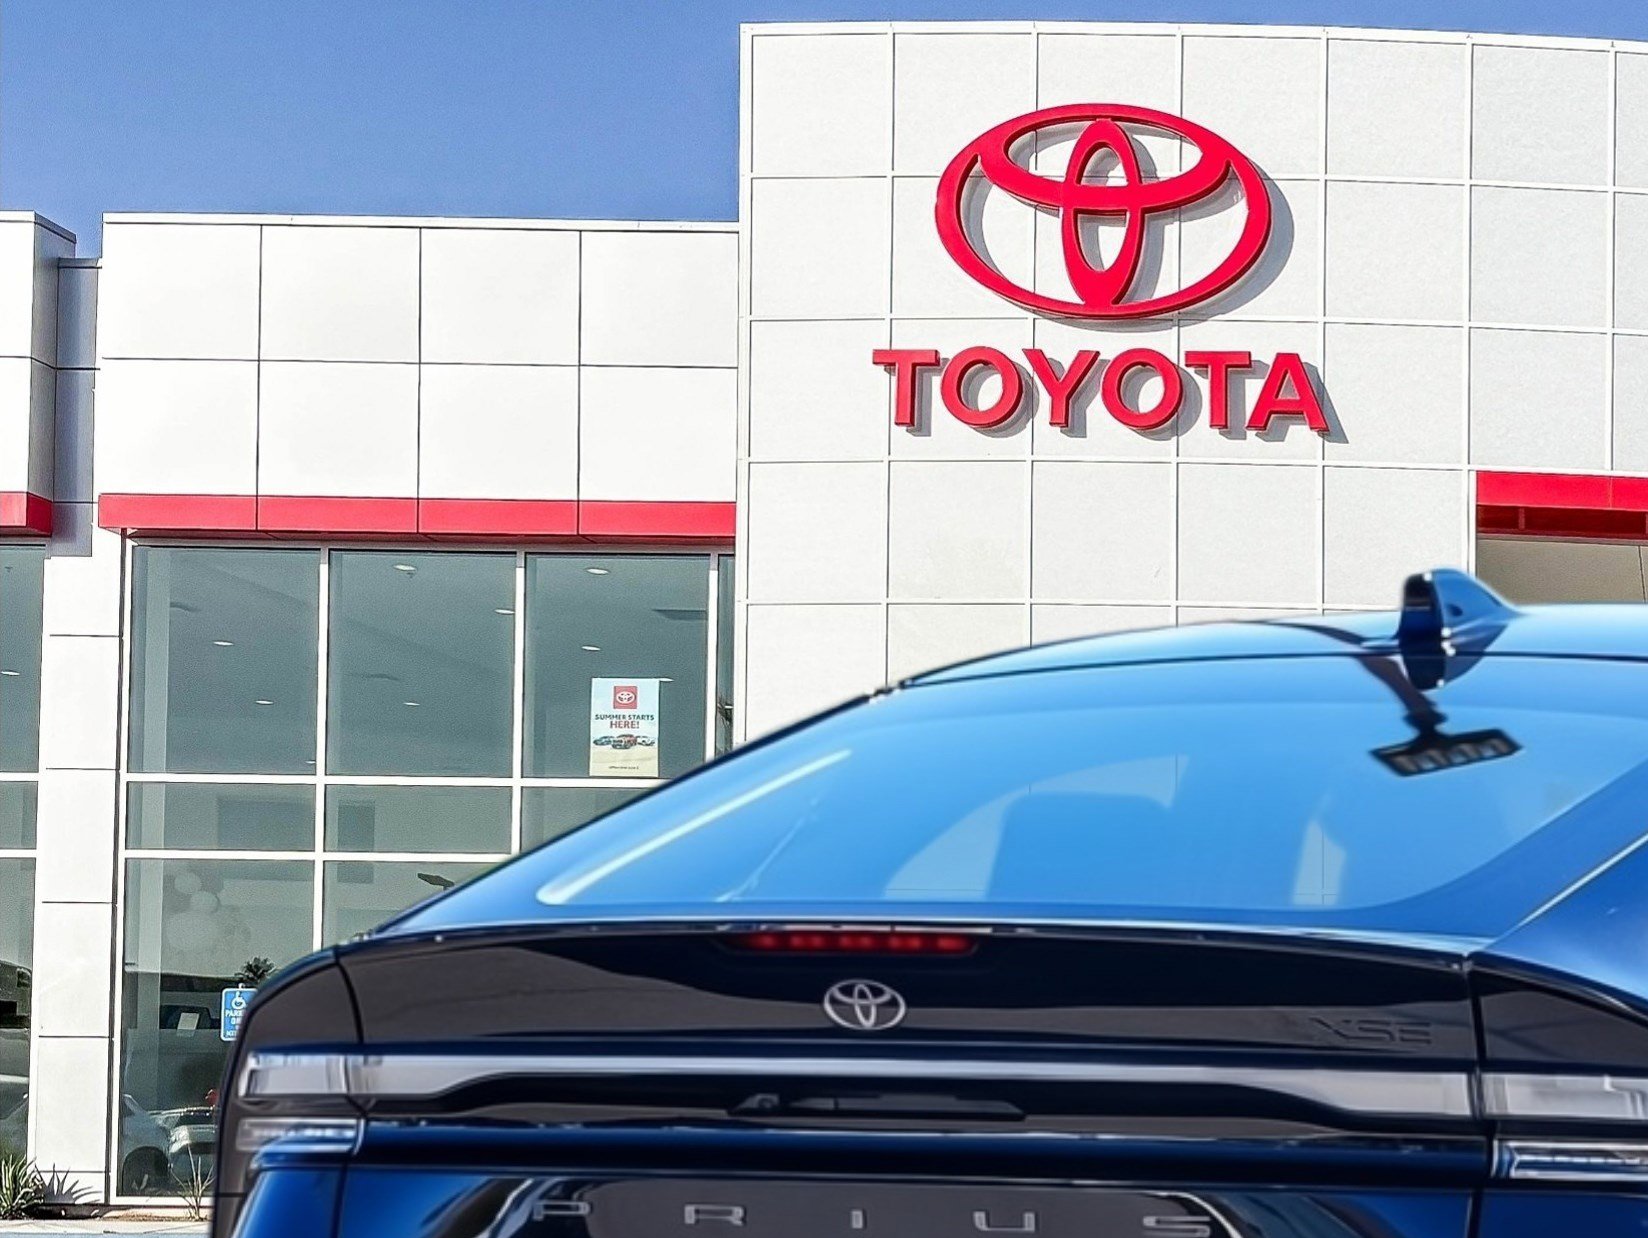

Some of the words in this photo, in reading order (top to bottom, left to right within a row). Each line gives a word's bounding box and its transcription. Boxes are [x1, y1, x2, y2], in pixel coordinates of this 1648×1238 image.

[873, 346, 1331, 435] TOYOTA
[609, 720, 640, 729] HERE!
[532, 1201, 1211, 1238] PRIUS
